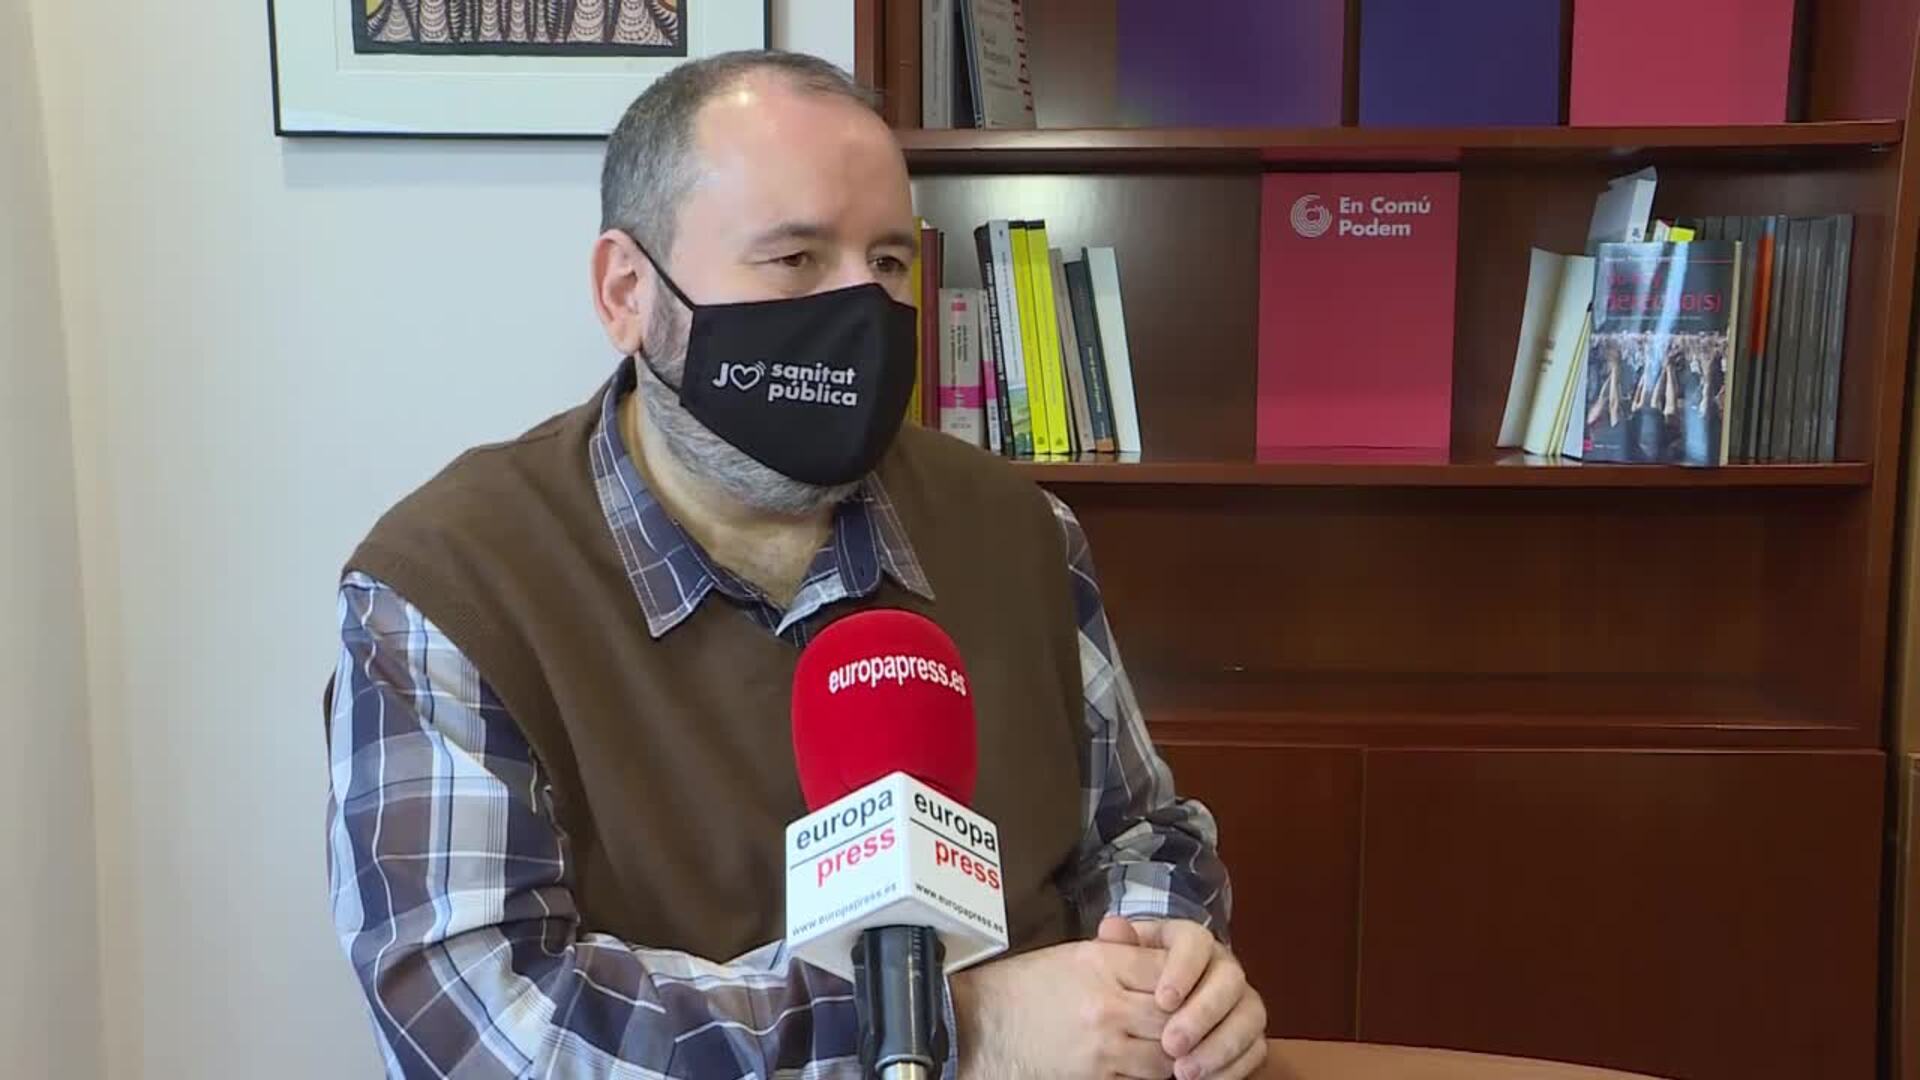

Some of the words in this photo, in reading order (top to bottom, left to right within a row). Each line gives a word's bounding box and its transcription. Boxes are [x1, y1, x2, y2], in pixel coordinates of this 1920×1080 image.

[1338, 196, 1364, 214] En
[1370, 195, 1431, 214] Comú
[1338, 218, 1412, 236] Podem
[767, 380, 859, 407] pública
[770, 362, 856, 386] sanitat
[828, 654, 967, 697] europapress.es
[795, 789, 895, 851] europa
[913, 791, 998, 853] europa
[816, 827, 897, 889] press
[934, 838, 1001, 891] press
[791, 882, 897, 938] www.europapress.es
[914, 881, 1005, 935] www.europapress.es
